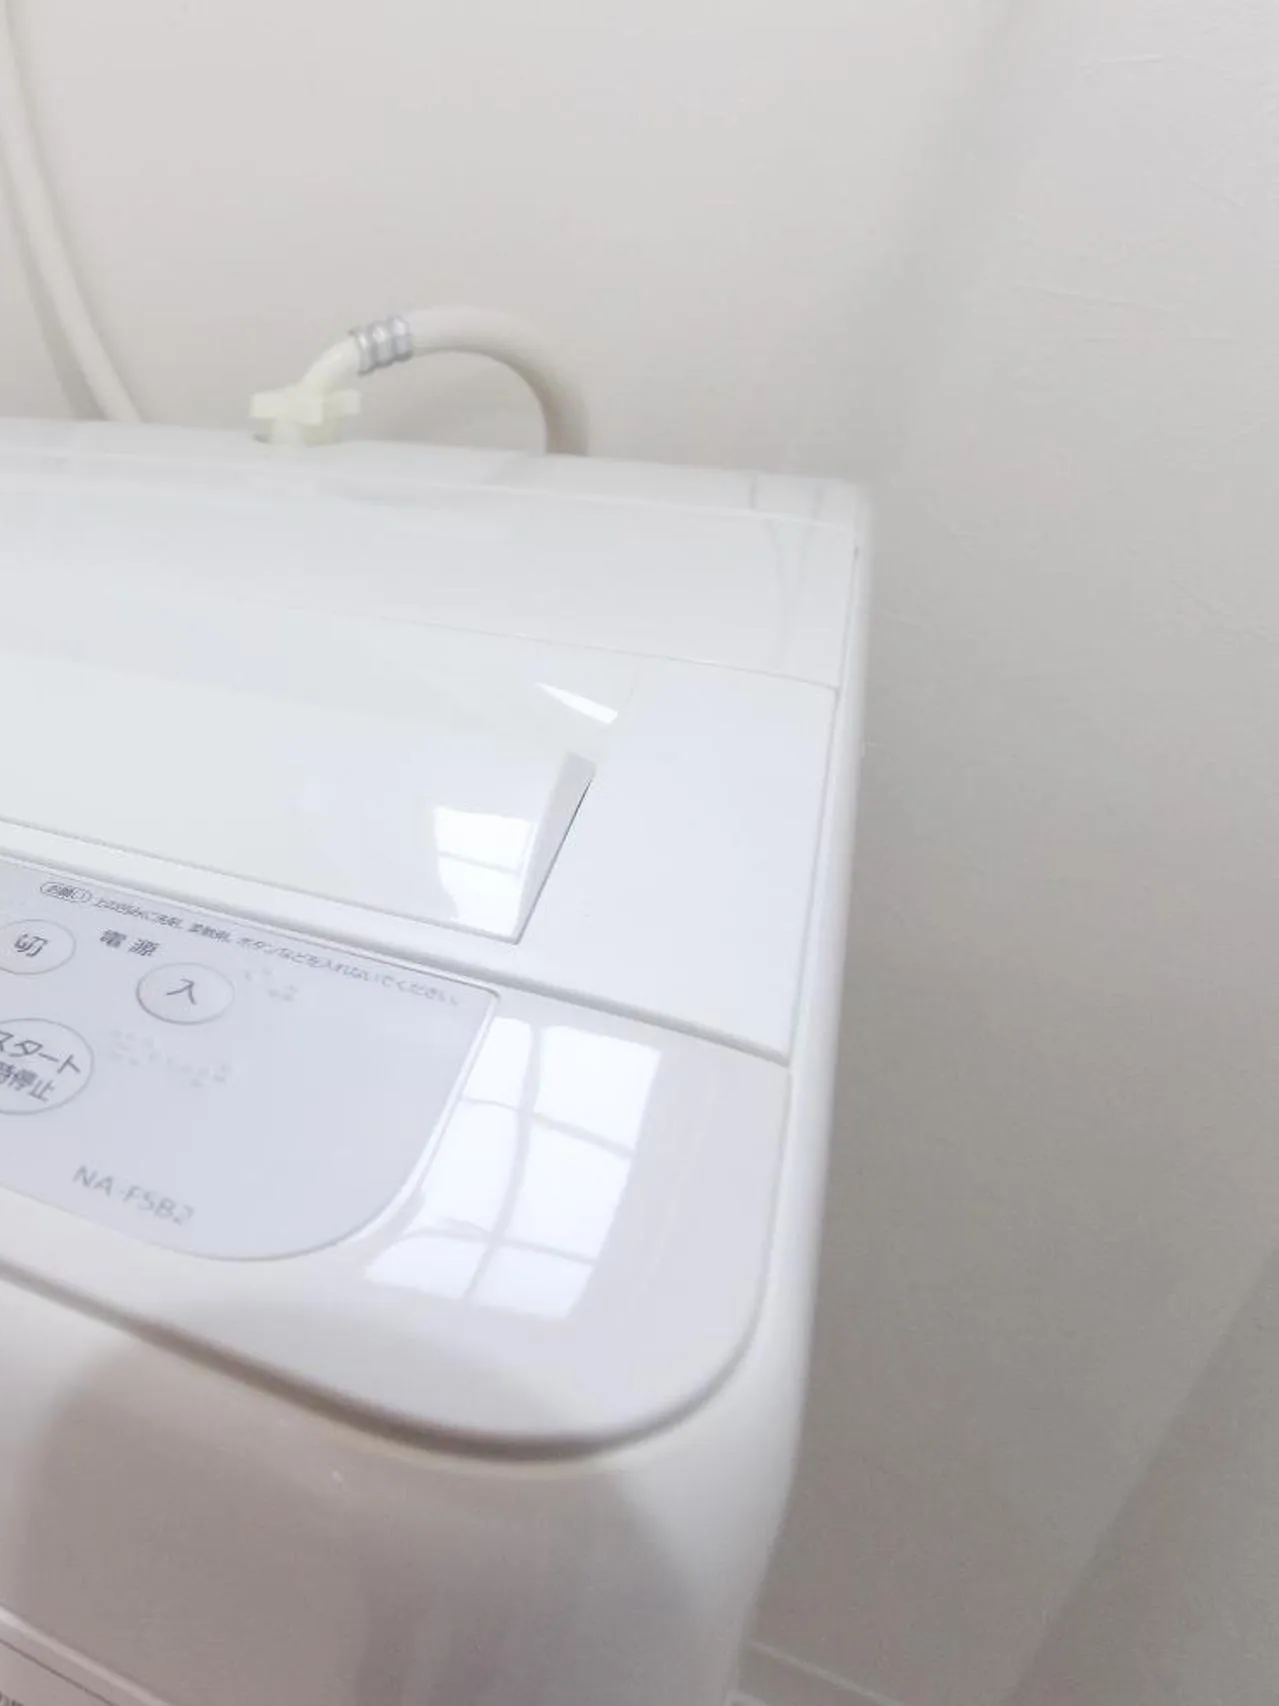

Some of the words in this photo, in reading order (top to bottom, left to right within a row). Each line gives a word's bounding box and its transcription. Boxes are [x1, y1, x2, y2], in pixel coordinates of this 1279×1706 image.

[13, 933, 49, 958] 切
[100, 928, 161, 957] 電源
[166, 977, 197, 1005] 入
